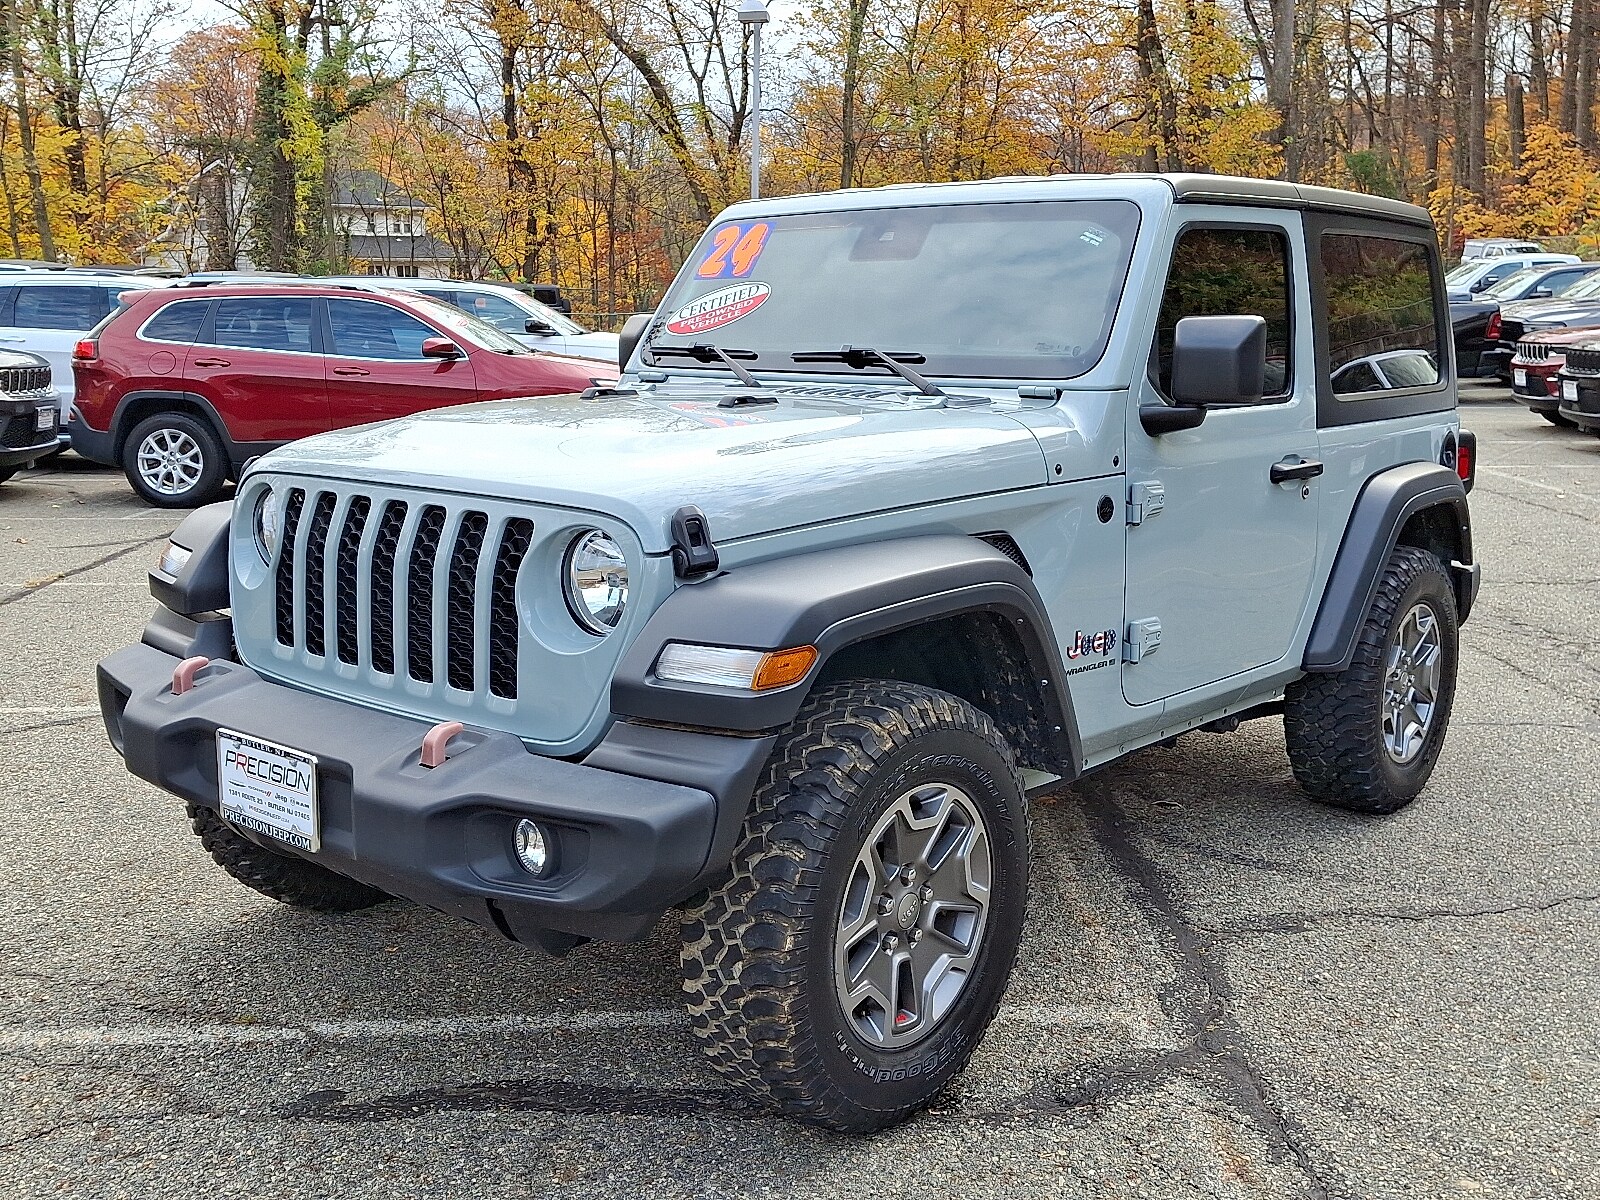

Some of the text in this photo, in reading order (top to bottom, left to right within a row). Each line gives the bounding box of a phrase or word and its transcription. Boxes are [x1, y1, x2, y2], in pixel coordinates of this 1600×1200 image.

[698, 223, 768, 277] 24
[679, 285, 760, 319] CERTIFIED
[680, 299, 754, 328] PRE-OWNED
[689, 310, 742, 331] VEHICLE
[1066, 629, 1116, 659] Jeep
[275, 748, 285, 757] NJ
[225, 750, 310, 792] PRECISION
[241, 791, 256, 803] ROUTE
[267, 801, 285, 813] BUTLER
[286, 807, 294, 816] NJ
[274, 792, 288, 804] Jeep
[223, 808, 311, 850] PRECISIONJEEP.COM
